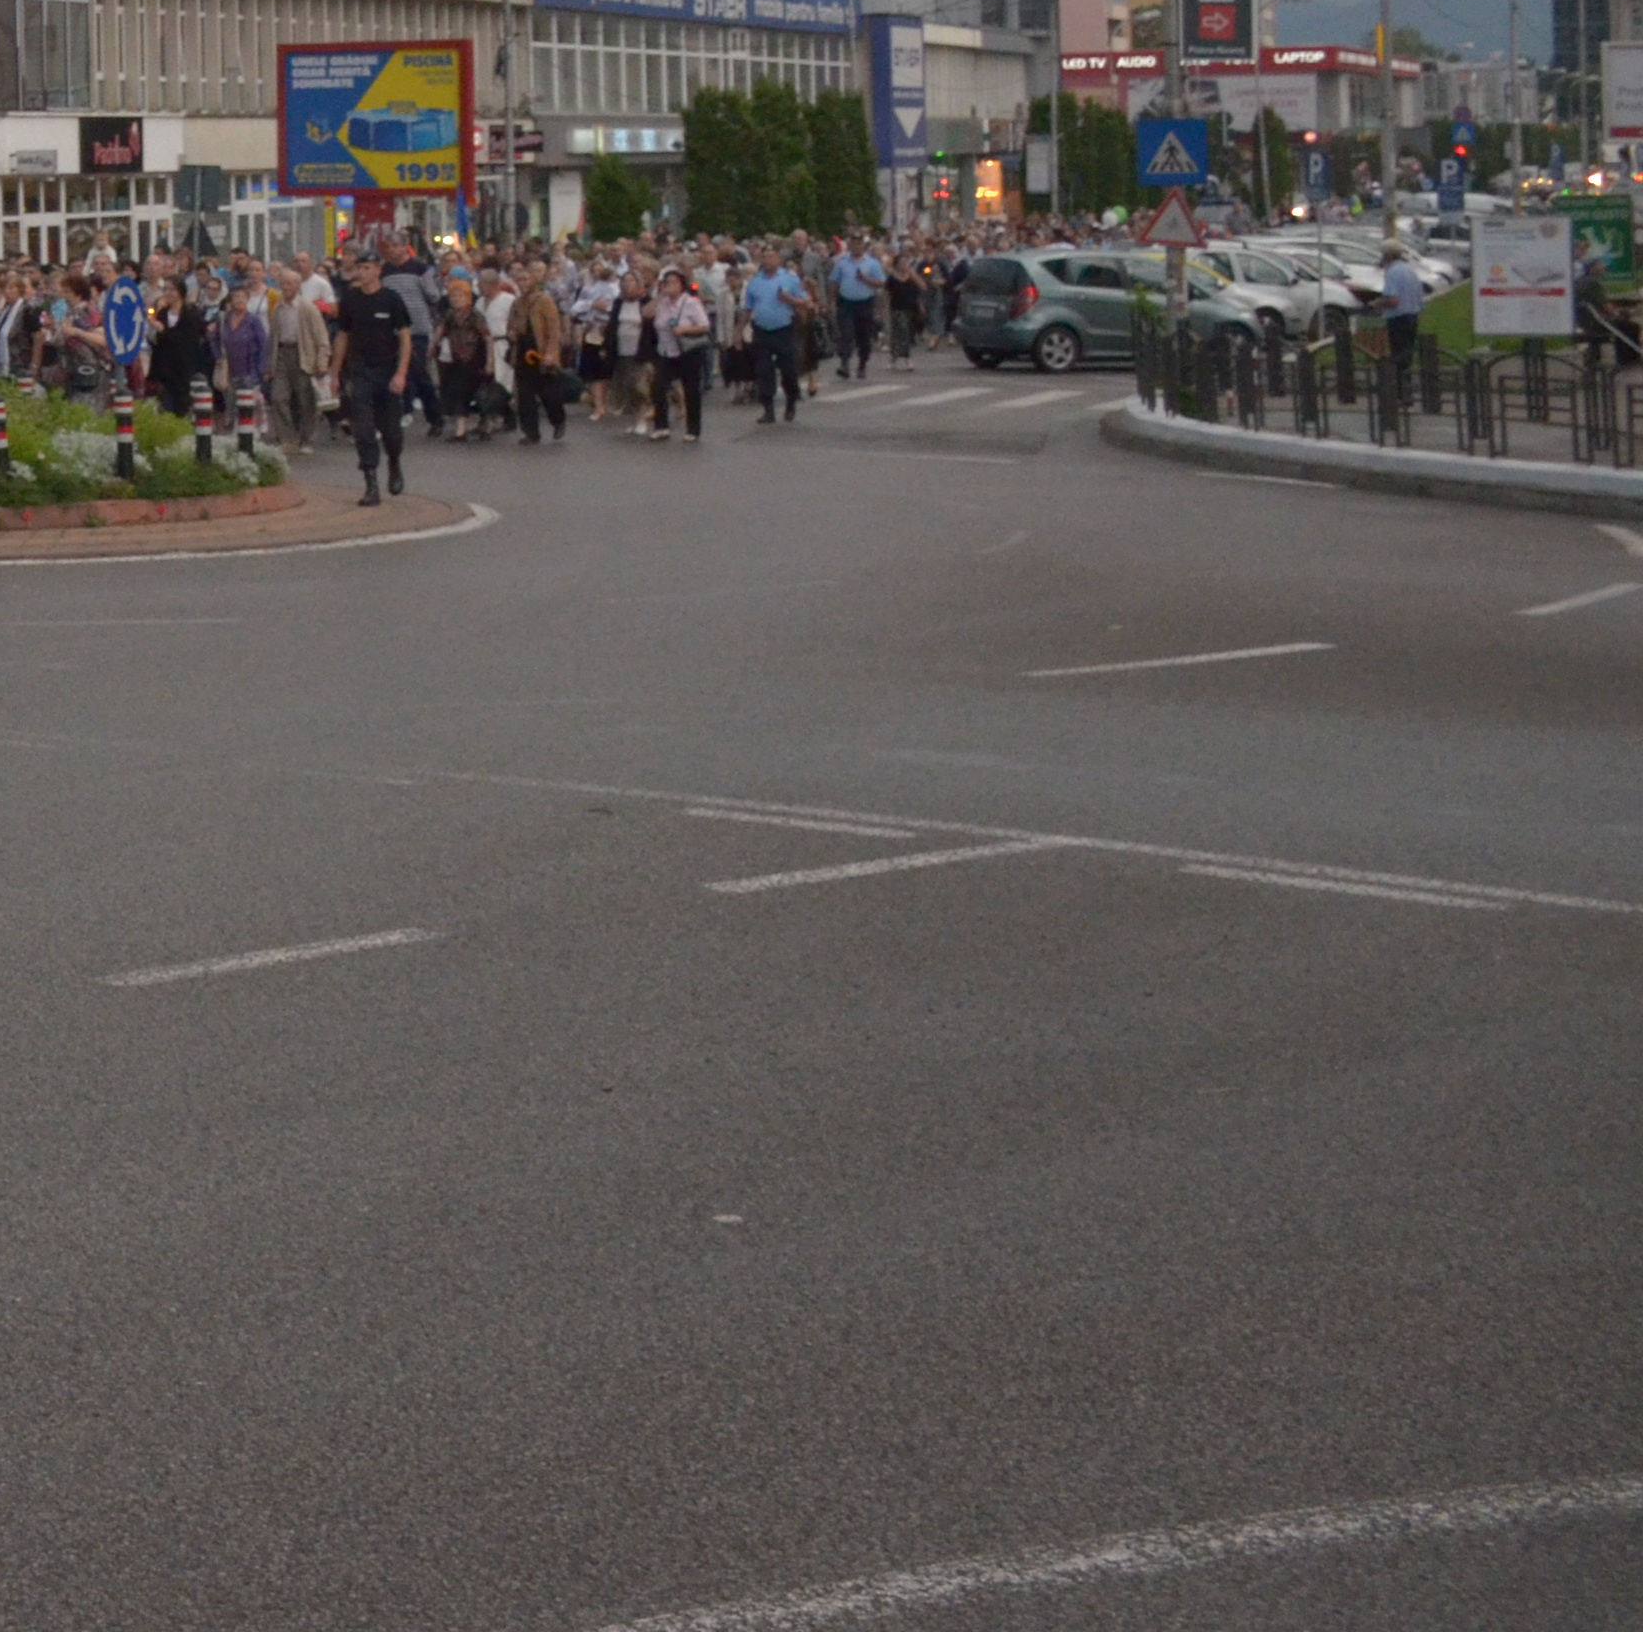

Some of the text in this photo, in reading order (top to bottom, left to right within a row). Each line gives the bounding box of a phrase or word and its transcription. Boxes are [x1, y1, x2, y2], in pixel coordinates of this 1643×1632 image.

[1062, 57, 1106, 70] LED TV
[1116, 55, 1157, 68] AUDIO
[1273, 51, 1325, 65] LAPTOP
[395, 162, 440, 183] 199
[1440, 159, 1459, 184] P
